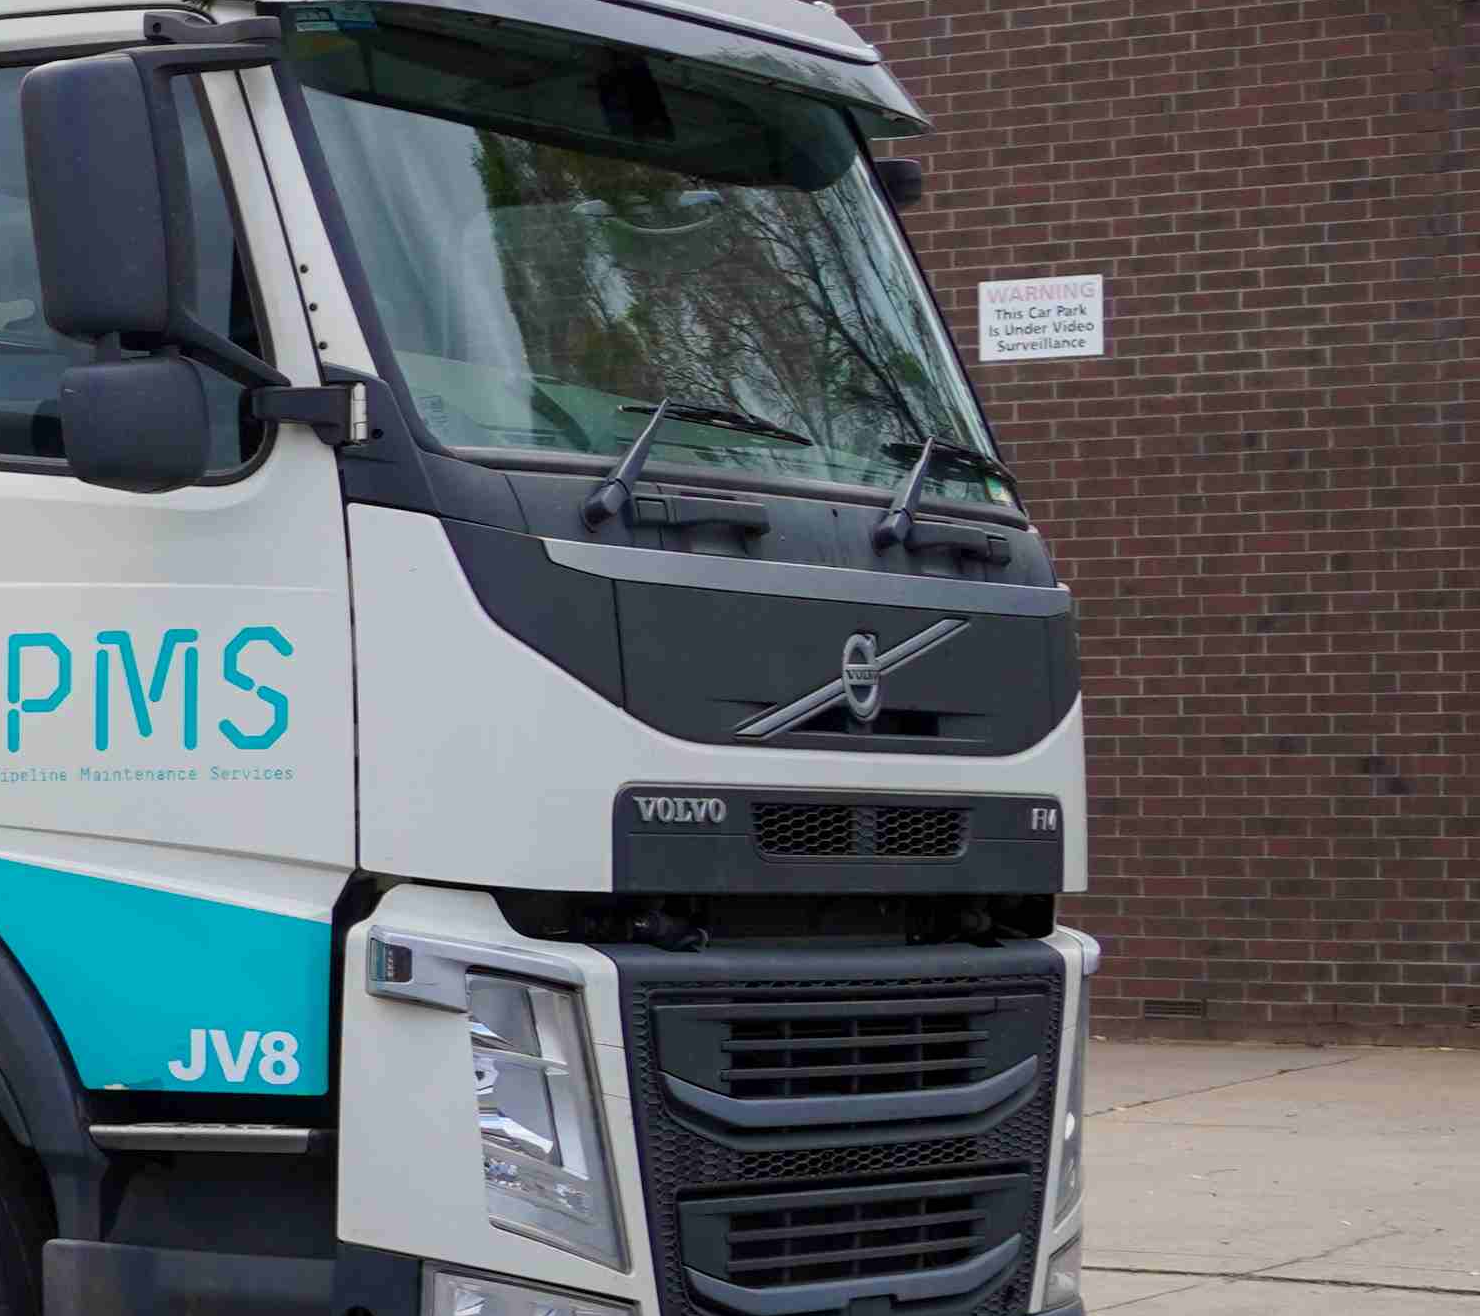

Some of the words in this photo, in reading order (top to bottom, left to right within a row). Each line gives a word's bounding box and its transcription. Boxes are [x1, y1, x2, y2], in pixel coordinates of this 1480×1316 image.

[985, 282, 1097, 303] WARNING
[994, 308, 1024, 321] This
[1028, 306, 1051, 319] Car
[1057, 303, 1088, 317] Park
[988, 325, 1000, 337] Is
[1005, 323, 1048, 336] Under
[1052, 320, 1095, 334] Video
[997, 337, 1088, 352] Surveillance
[80, 766, 199, 782] Maintenance
[209, 765, 295, 781] Services
[632, 796, 727, 823] VOLVO
[167, 1028, 301, 1086] JV8
